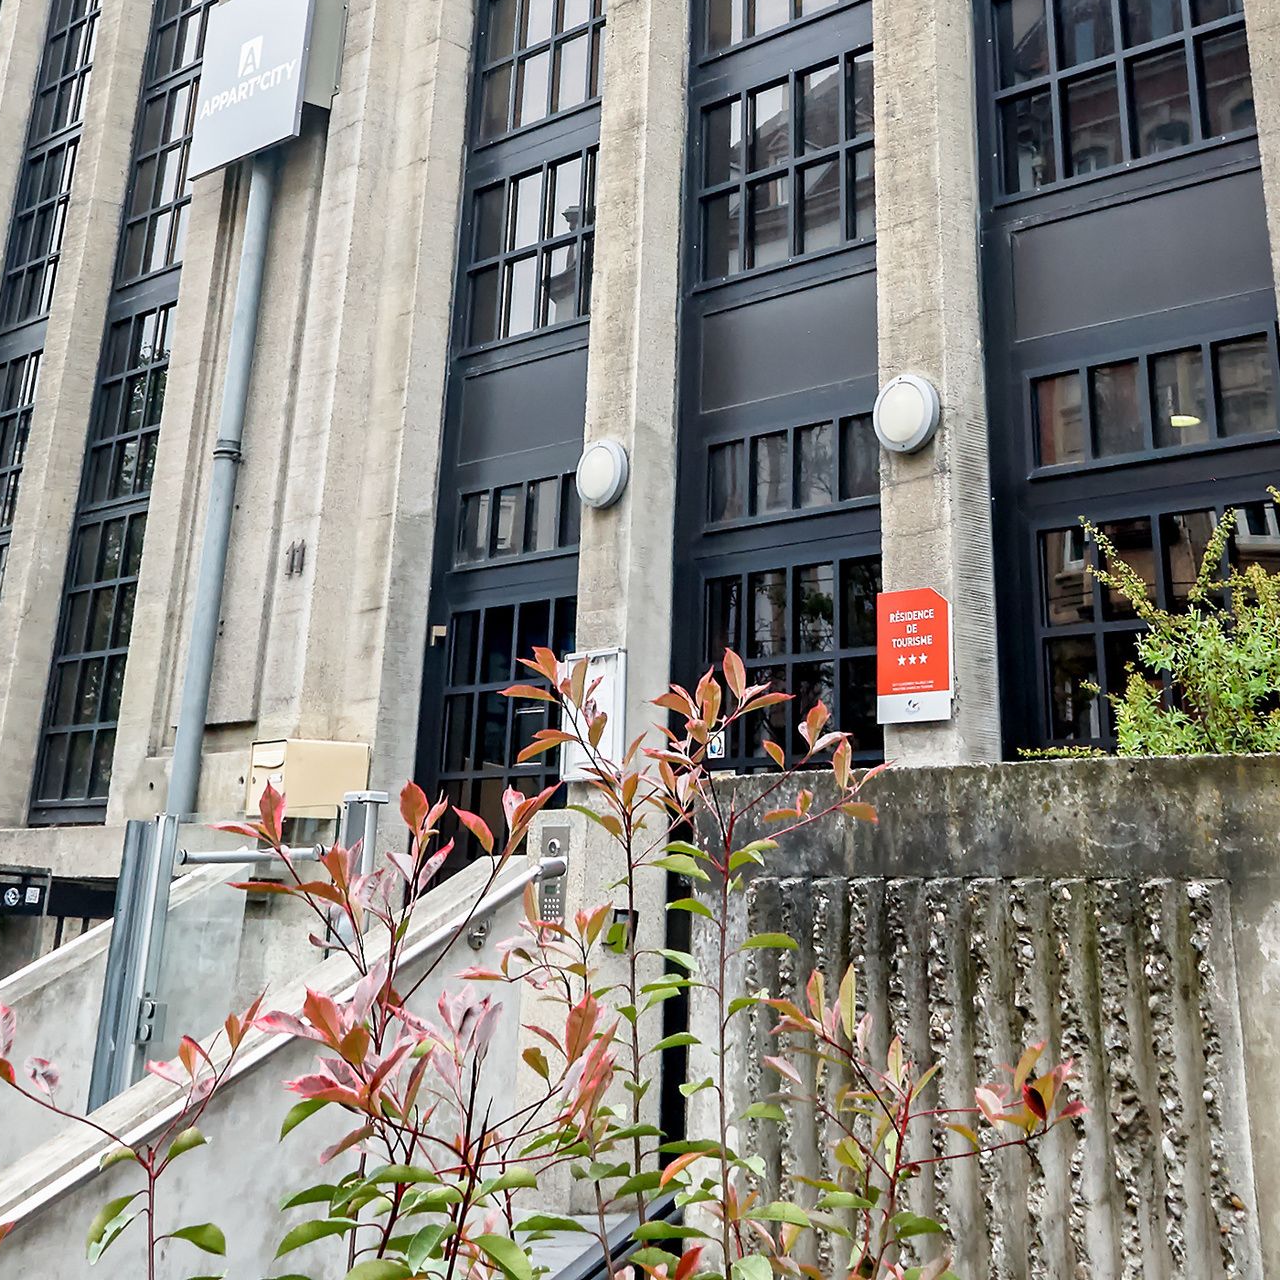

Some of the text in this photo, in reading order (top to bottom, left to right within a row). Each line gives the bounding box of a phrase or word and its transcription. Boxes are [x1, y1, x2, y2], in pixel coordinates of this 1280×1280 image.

[199, 58, 297, 120] APPART'CITY
[889, 608, 934, 623] RÉSIDENCE
[906, 623, 918, 634] DE
[891, 635, 933, 648] TOURISME
